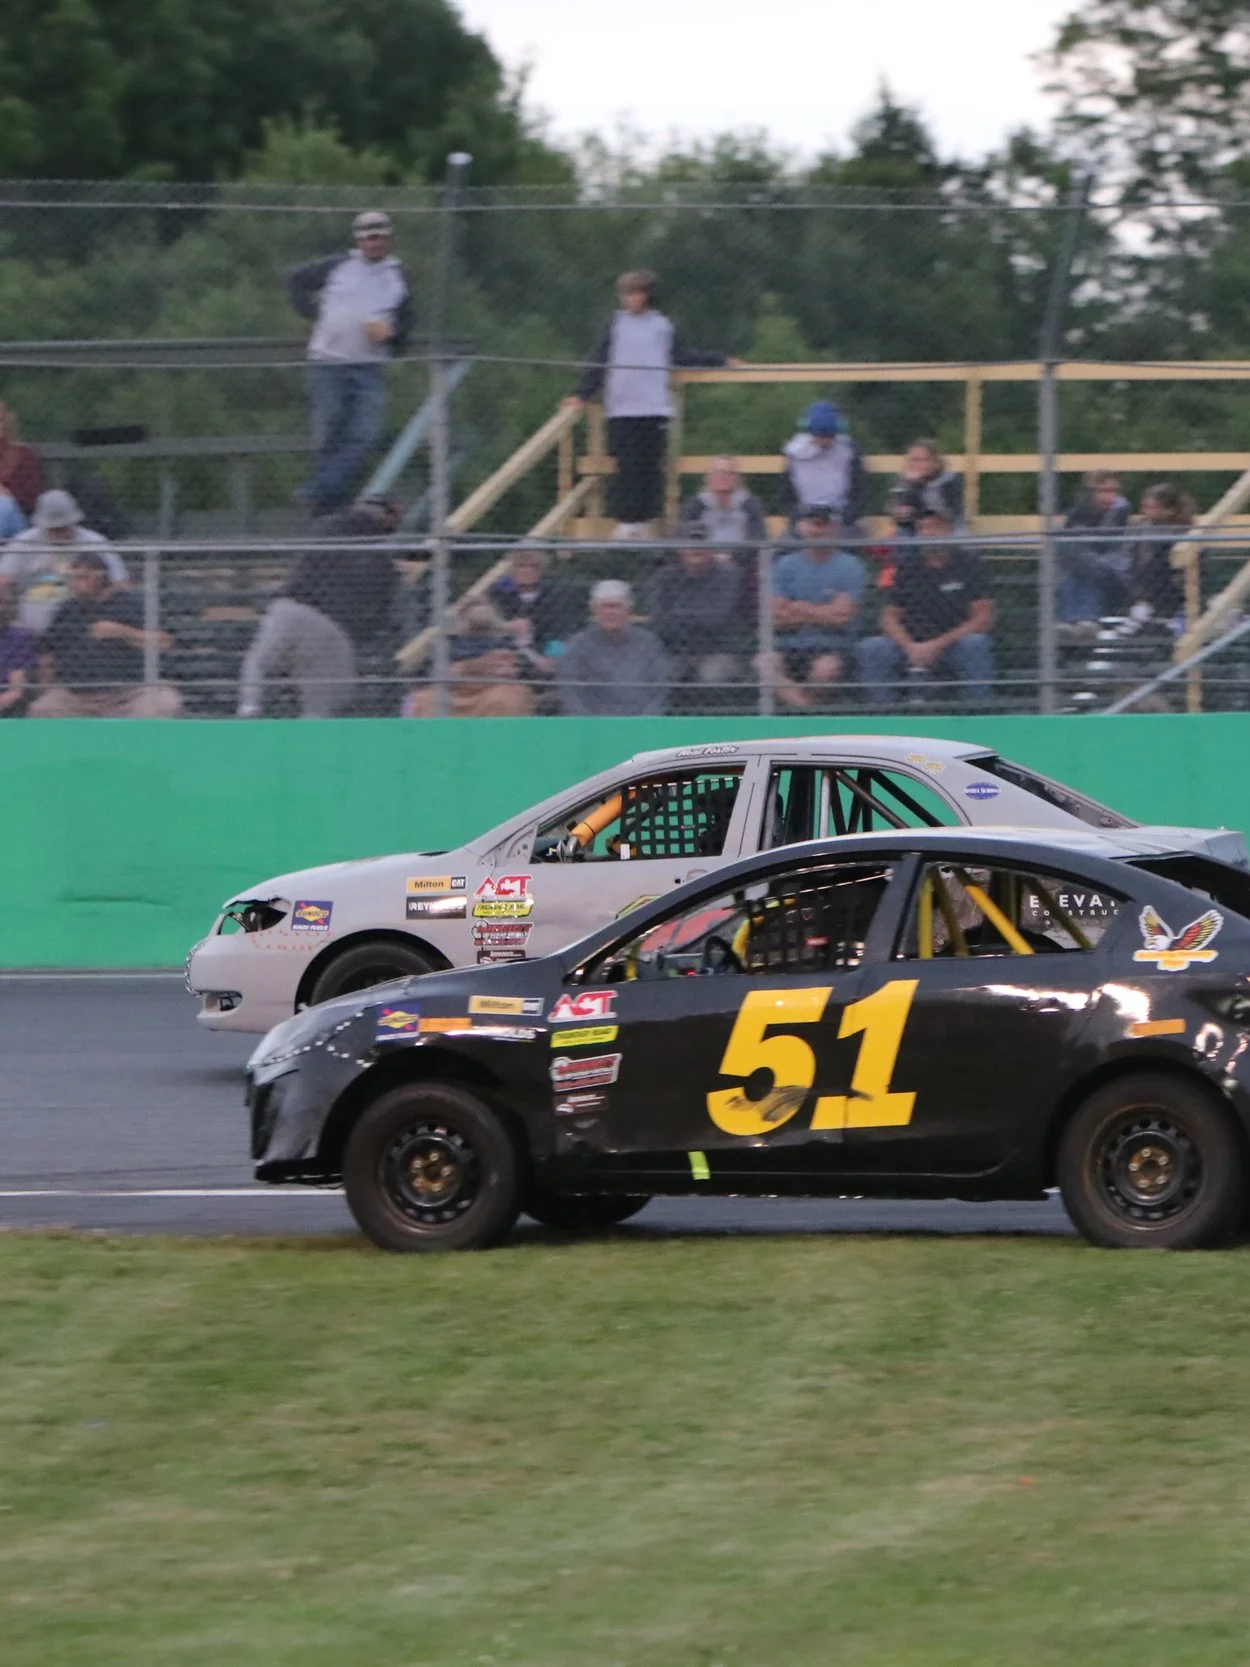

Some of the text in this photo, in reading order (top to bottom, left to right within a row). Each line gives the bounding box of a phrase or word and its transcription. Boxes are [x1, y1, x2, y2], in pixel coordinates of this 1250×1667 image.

[414, 880, 444, 889] Milton
[474, 874, 533, 896] ACT
[548, 990, 618, 1022] ACT
[706, 979, 920, 1137] 51
